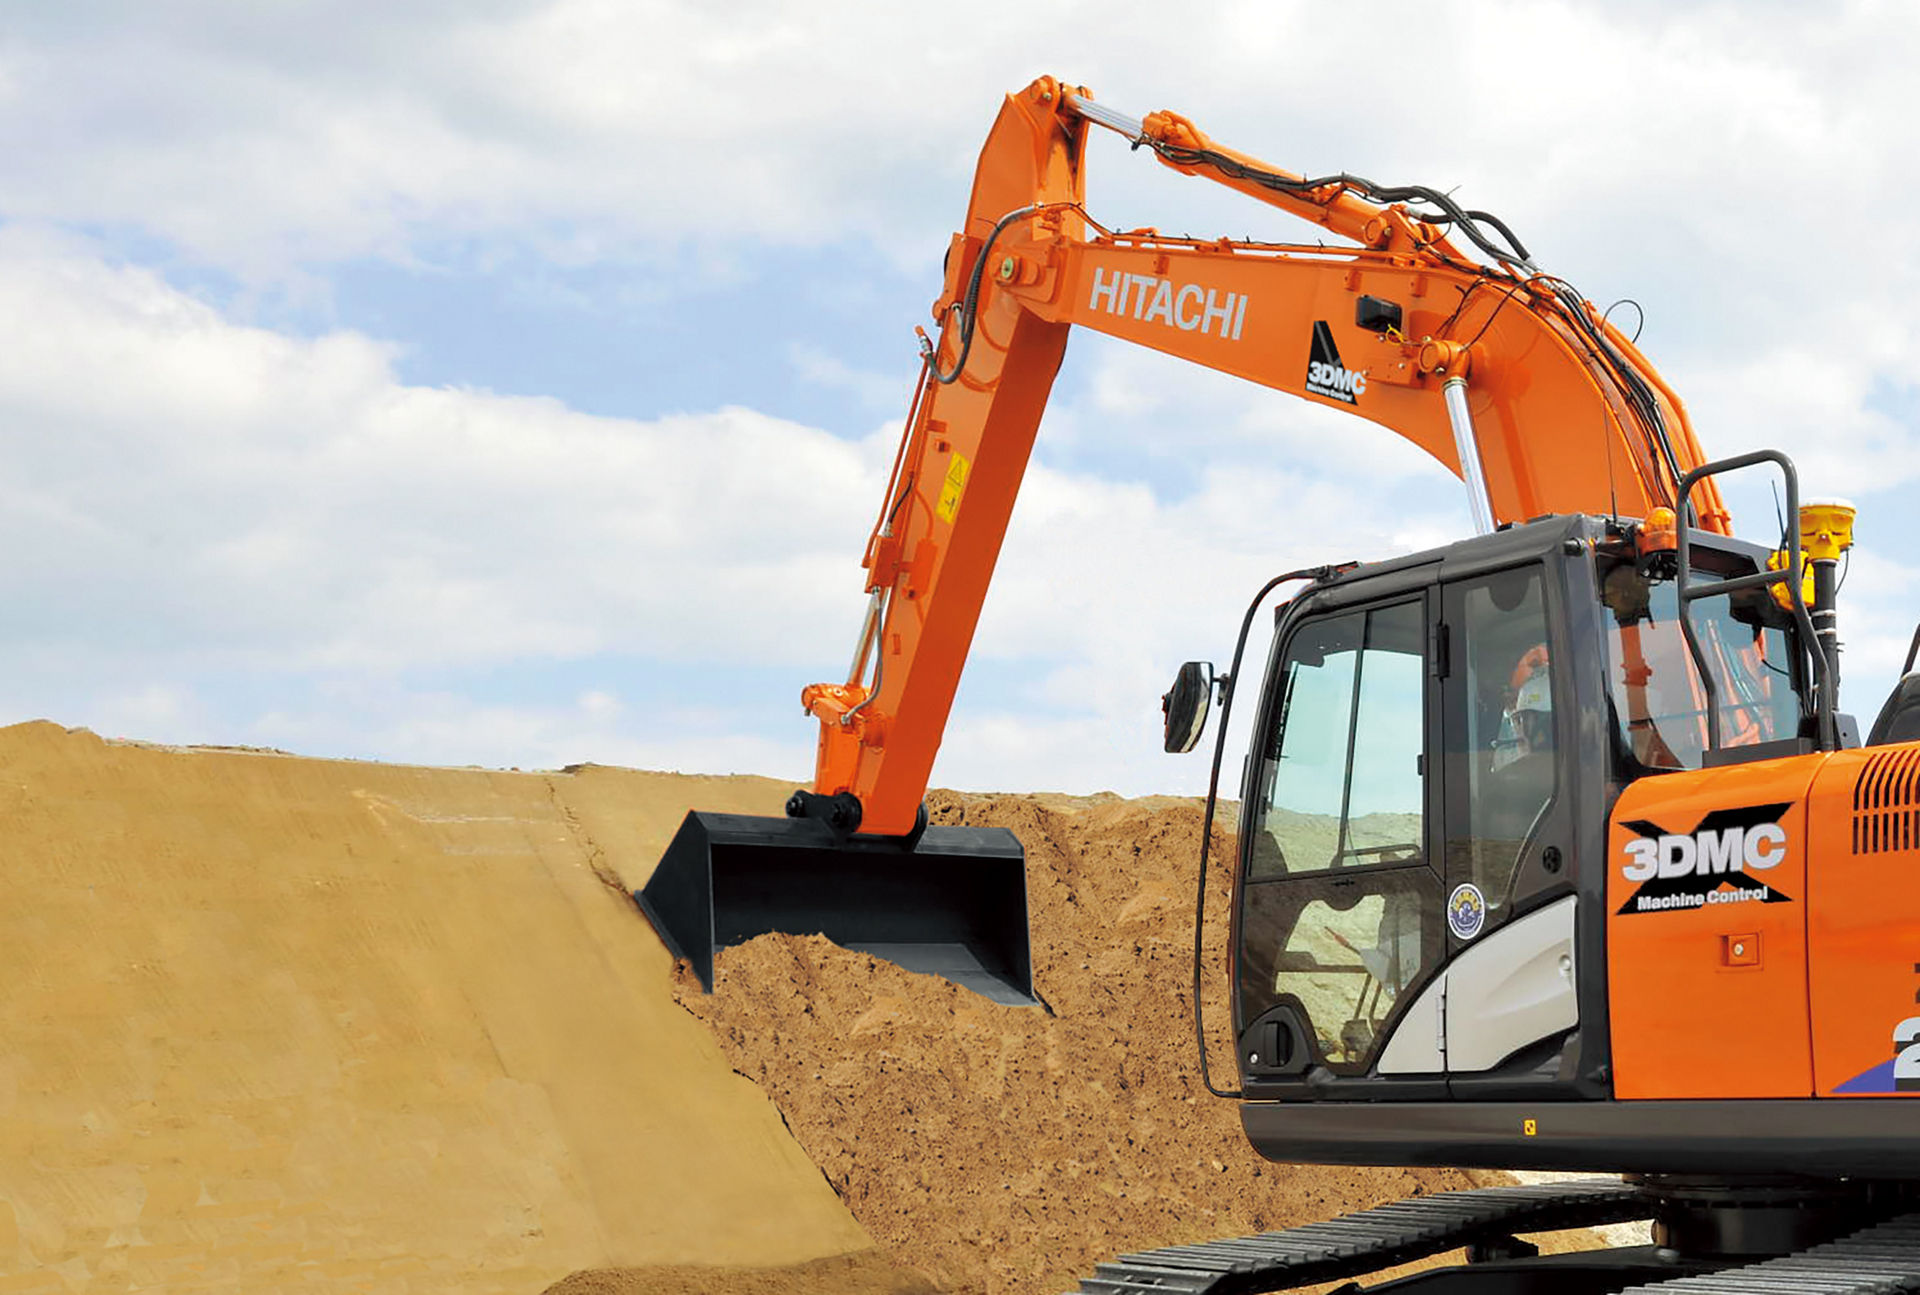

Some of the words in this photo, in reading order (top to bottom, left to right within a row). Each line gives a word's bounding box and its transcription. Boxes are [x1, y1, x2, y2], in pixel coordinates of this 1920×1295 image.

[1089, 267, 1248, 340] HITACHI
[1308, 361, 1367, 395] 3DMC
[1622, 823, 1786, 882] 3DMC
[1637, 891, 1705, 911] Machine
[1707, 886, 1768, 904] Control
